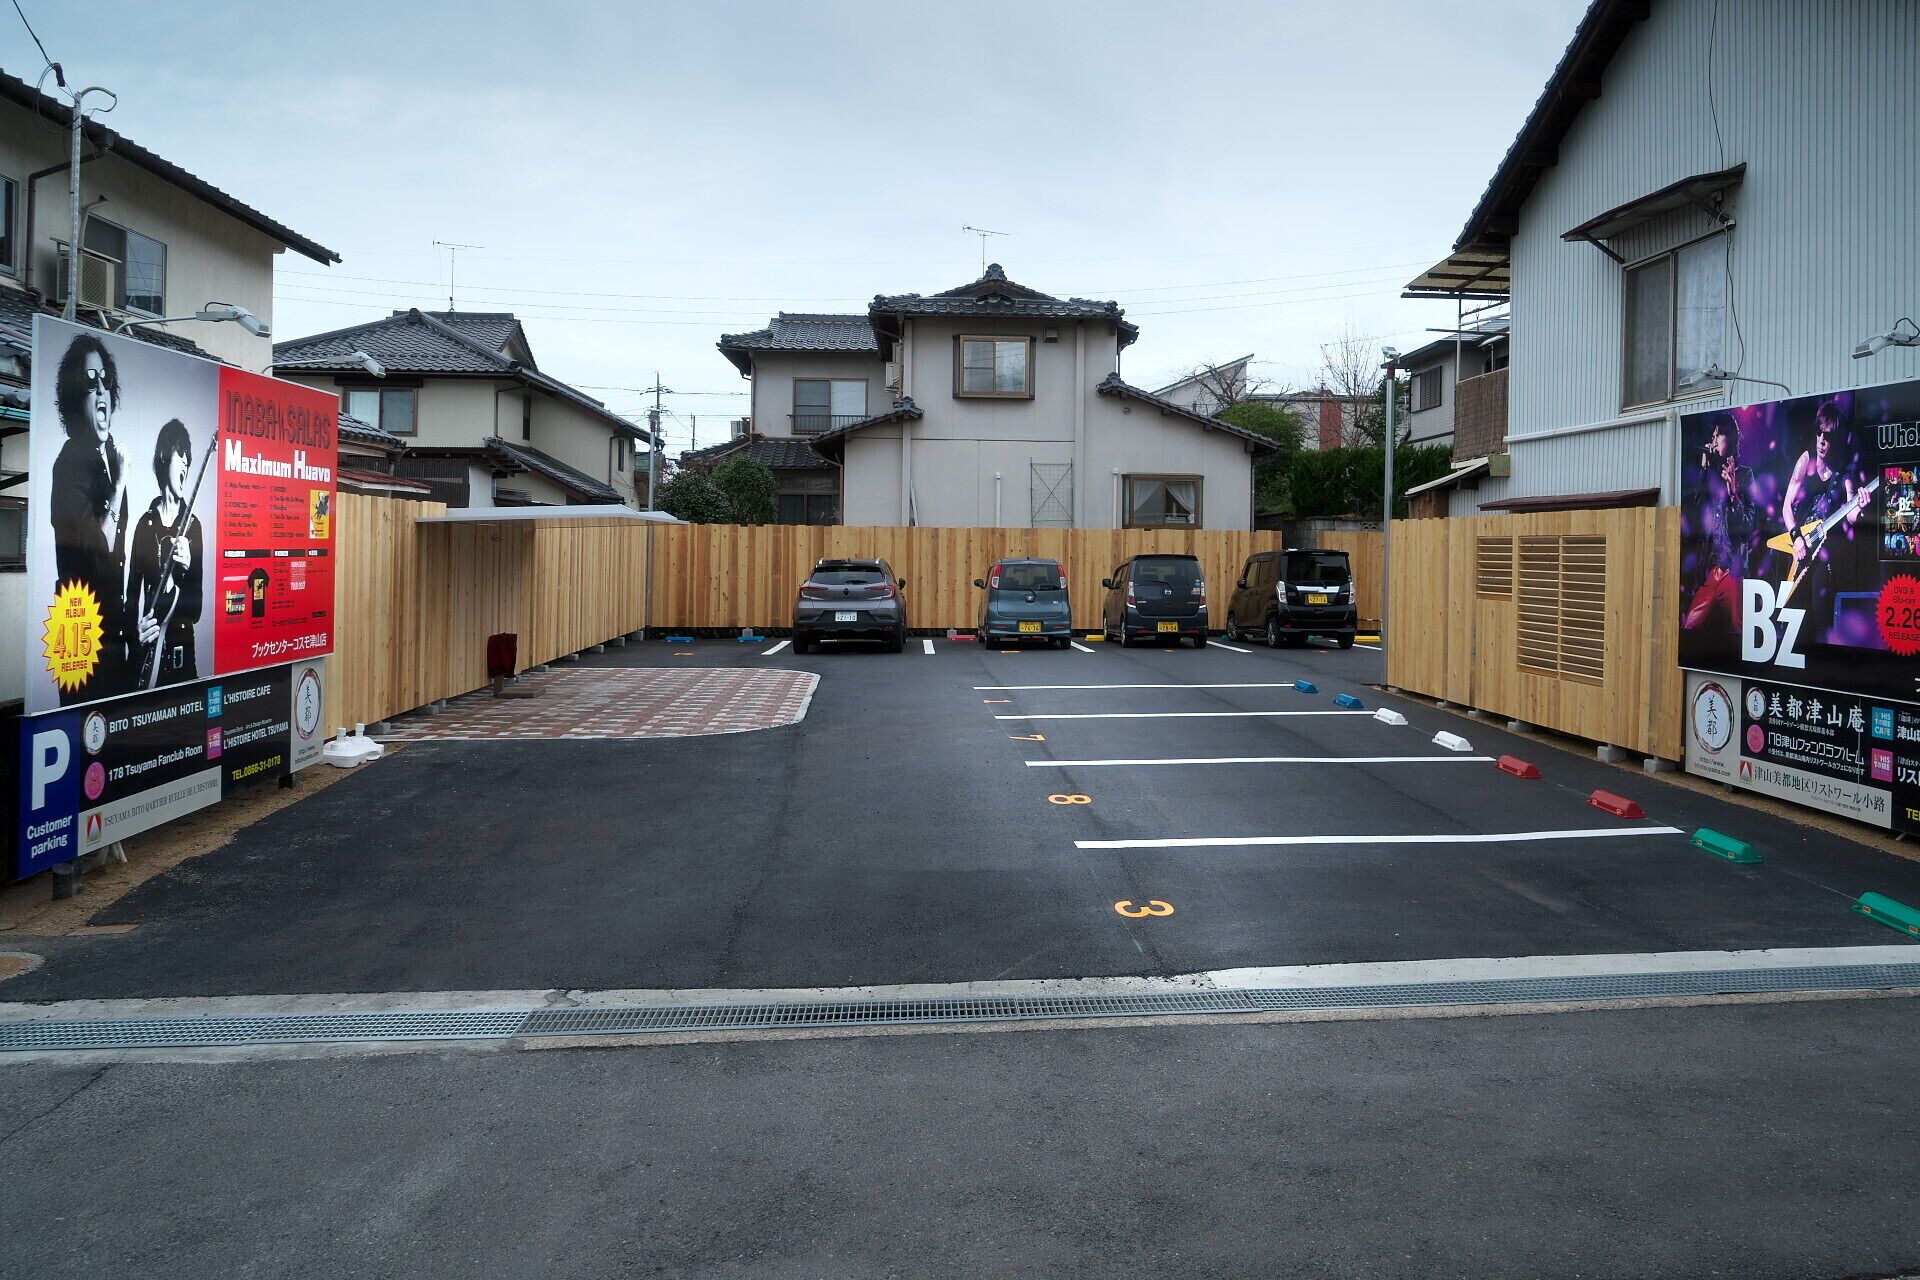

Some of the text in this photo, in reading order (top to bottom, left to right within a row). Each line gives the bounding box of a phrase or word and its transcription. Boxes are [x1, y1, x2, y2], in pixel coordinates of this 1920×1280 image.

[225, 439, 330, 482] Maximum Huavo
[66, 608, 86, 618] ALBUM
[70, 598, 82, 607] NEW
[1742, 578, 1806, 669] B'z
[54, 621, 92, 659] 4.15
[61, 660, 88, 672] RELEASE
[256, 685, 271, 697] CAFE
[109, 701, 203, 733] BITO TSUYAMAAN HOTEL
[1768, 692, 1865, 732] 美都津山庵
[31, 728, 71, 811] P
[108, 766, 124, 782] 178
[125, 758, 157, 776] Tsuyama
[158, 749, 184, 766] Fanclub
[185, 745, 203, 760] Room
[1754, 765, 1885, 813] 津山美都地区リストワール小路
[1897, 766, 1920, 787] リス
[1047, 794, 1092, 805] 8
[26, 815, 73, 840] Customer
[31, 834, 68, 859] parking
[1114, 900, 1175, 918] 3
